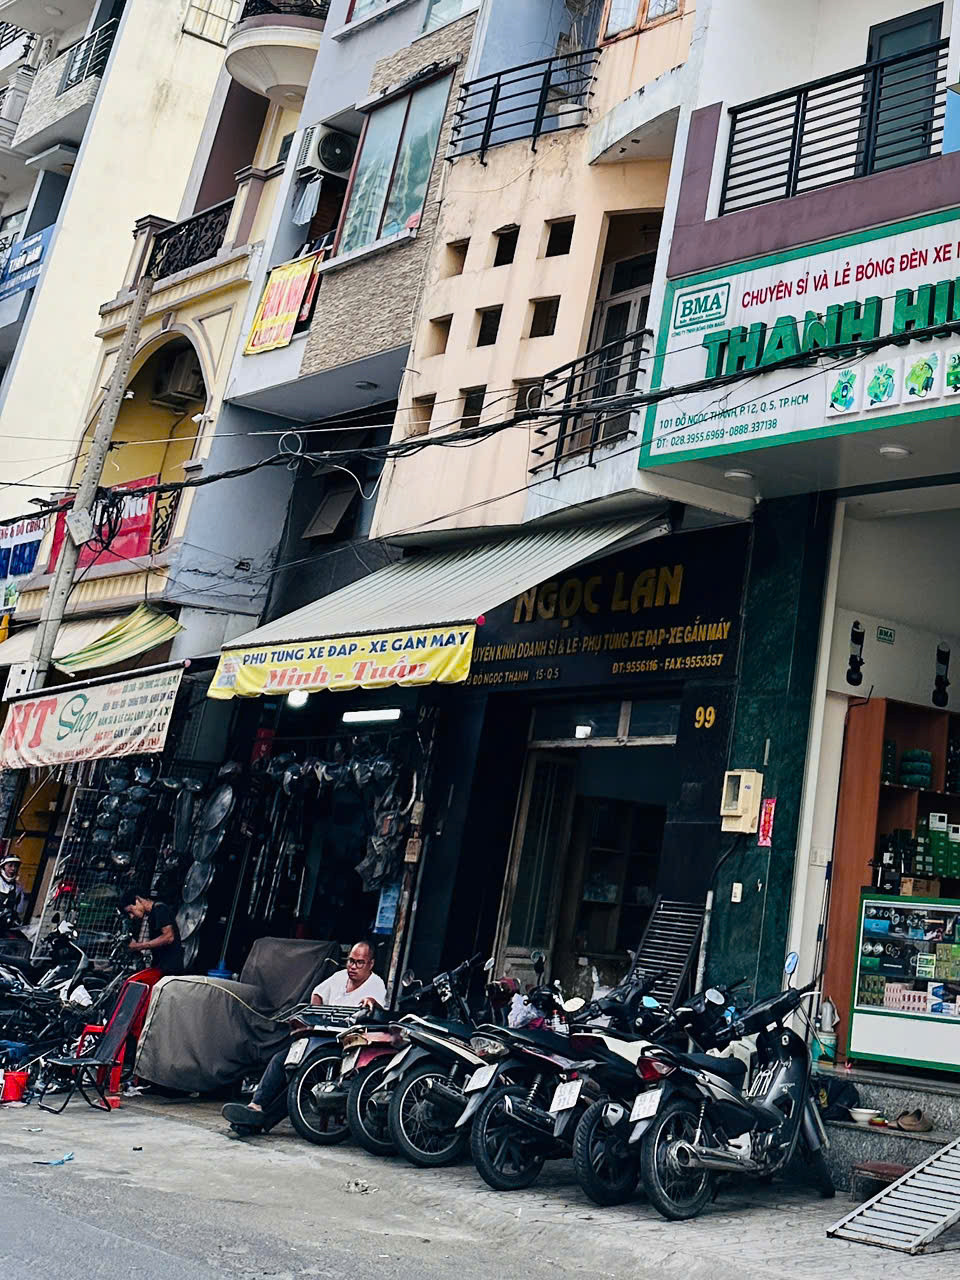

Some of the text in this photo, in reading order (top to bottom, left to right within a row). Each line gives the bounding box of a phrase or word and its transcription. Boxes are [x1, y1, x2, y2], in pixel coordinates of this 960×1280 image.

[741, 280, 793, 308] CHUYÊN
[796, 272, 810, 295] SỈ
[813, 269, 829, 291] VÀ
[834, 262, 851, 287] LẺ
[855, 258, 895, 282] BÓNG
[899, 248, 928, 272] ĐÈN
[933, 243, 952, 264] XE
[680, 292, 721, 318] BMA
[702, 296, 882, 380] THANH
[660, 419, 673, 430] 101
[779, 393, 809, 410] TP.HCM
[513, 563, 685, 628] NGỌC LAN
[307, 646, 326, 659] XE
[369, 640, 388, 654] XE
[495, 642, 516, 661] KINH
[517, 640, 546, 659] DOANH
[629, 630, 645, 648] XE
[645, 628, 665, 651] ĐẠP
[668, 627, 684, 645] XE
[707, 617, 731, 640] MÁY
[264, 665, 328, 689] Minh
[353, 655, 428, 681] Tuấn
[694, 706, 715, 728] 99
